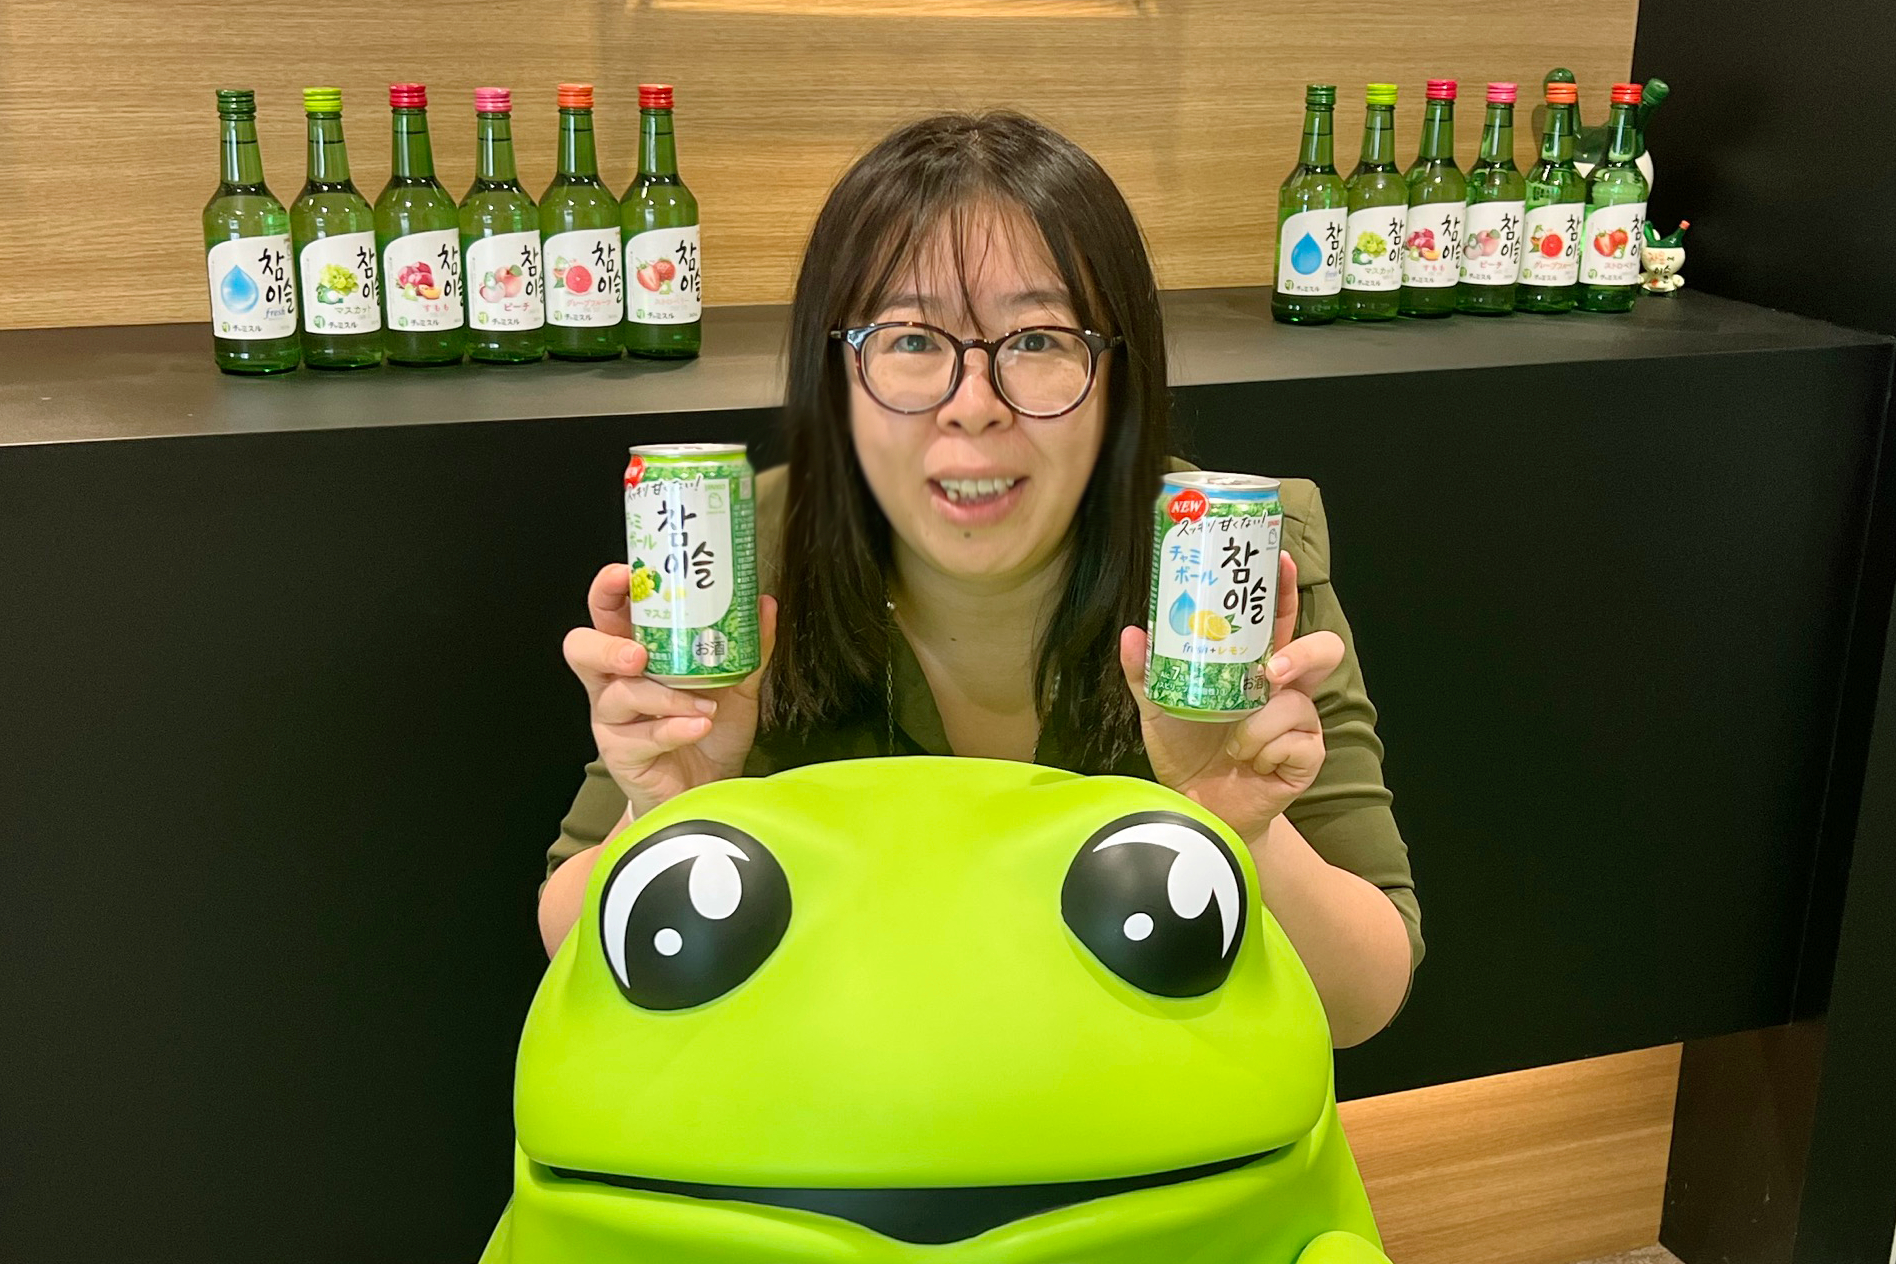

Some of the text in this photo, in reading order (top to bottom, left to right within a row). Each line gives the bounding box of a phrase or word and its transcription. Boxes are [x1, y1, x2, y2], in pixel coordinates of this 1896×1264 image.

[1325, 221, 1343, 250] 참
[1388, 217, 1404, 246] 참
[1441, 214, 1460, 242] 참
[1500, 213, 1520, 241] 참
[1565, 214, 1582, 242] 참
[258, 248, 284, 281] 참
[357, 246, 375, 279] 참
[437, 243, 458, 276] 참
[521, 244, 539, 277] 참
[592, 241, 615, 273] 참
[675, 240, 697, 271] 참
[1500, 237, 1520, 265] 이슬
[266, 277, 294, 314] 이슬
[334, 305, 372, 315] マスカット
[1171, 500, 1203, 513] NEW
[657, 500, 697, 547] 참
[1177, 519, 1217, 537] スッキリ
[664, 541, 715, 589] 이슬
[1169, 545, 1200, 565] チャミ
[1221, 536, 1259, 584] 참
[1174, 566, 1219, 586] ボール
[1223, 577, 1266, 625] 이슬
[695, 636, 725, 656] お酒
